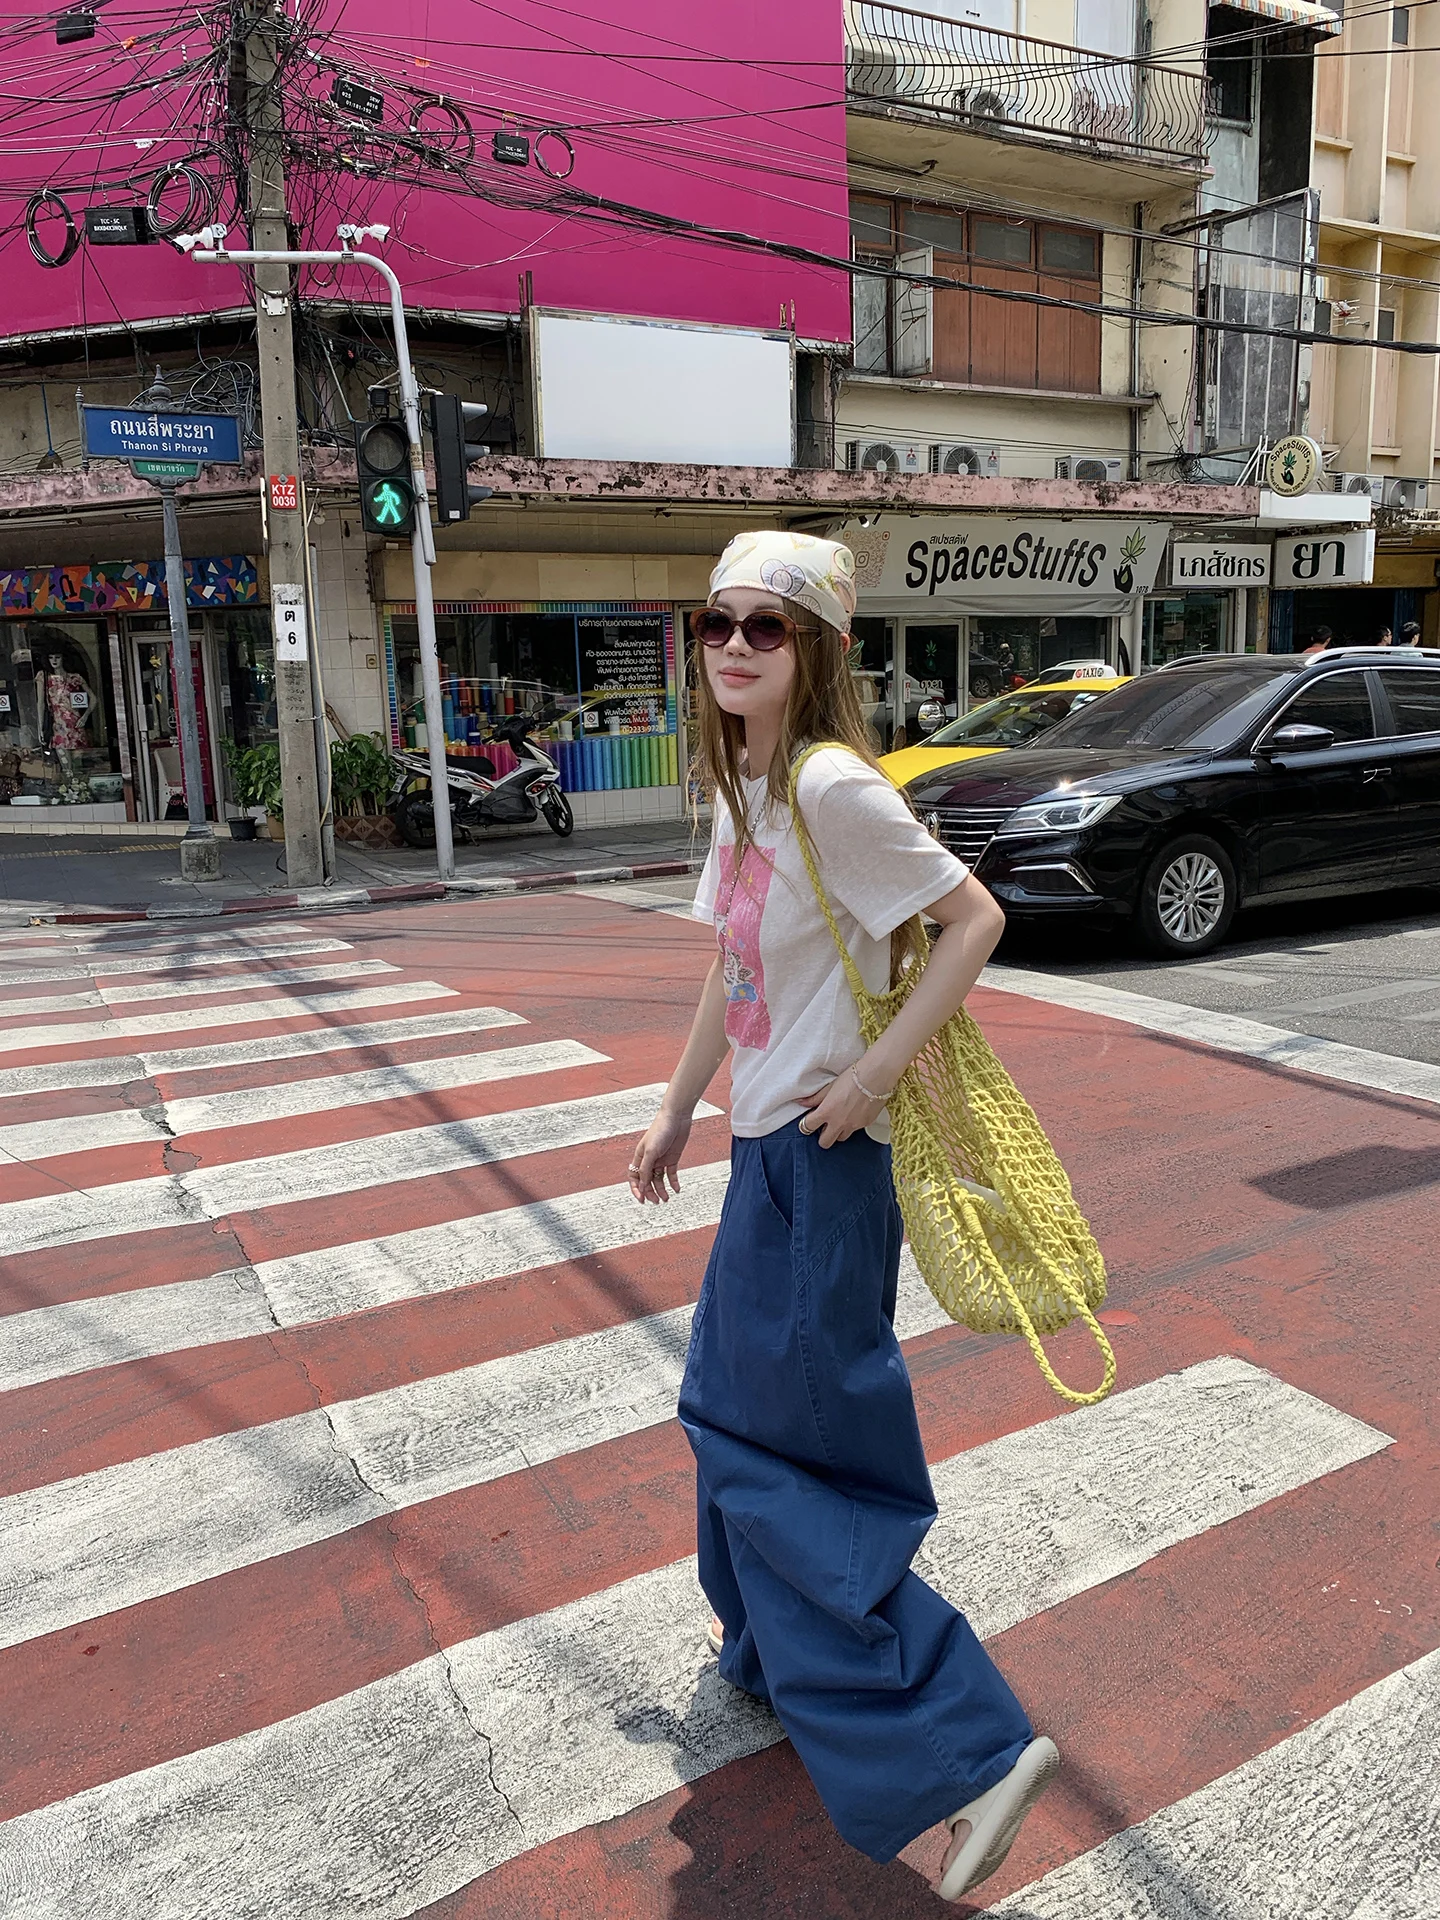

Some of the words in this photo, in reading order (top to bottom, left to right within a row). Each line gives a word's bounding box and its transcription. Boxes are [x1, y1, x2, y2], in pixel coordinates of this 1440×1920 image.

[110, 414, 214, 440] ถนนสี่พระยา
[121, 440, 159, 451] Thanon
[162, 442, 172, 452] Si
[175, 443, 209, 455] Phraya
[147, 463, 186, 473] เขตบางรัก
[272, 484, 296, 496] KTZ
[272, 496, 296, 507] 0030
[1180, 550, 1266, 577] เภสัชกร
[1292, 540, 1346, 580] ยา
[287, 632, 297, 645] 6
[1082, 667, 1097, 678] TAXI
[920, 680, 943, 694] open
